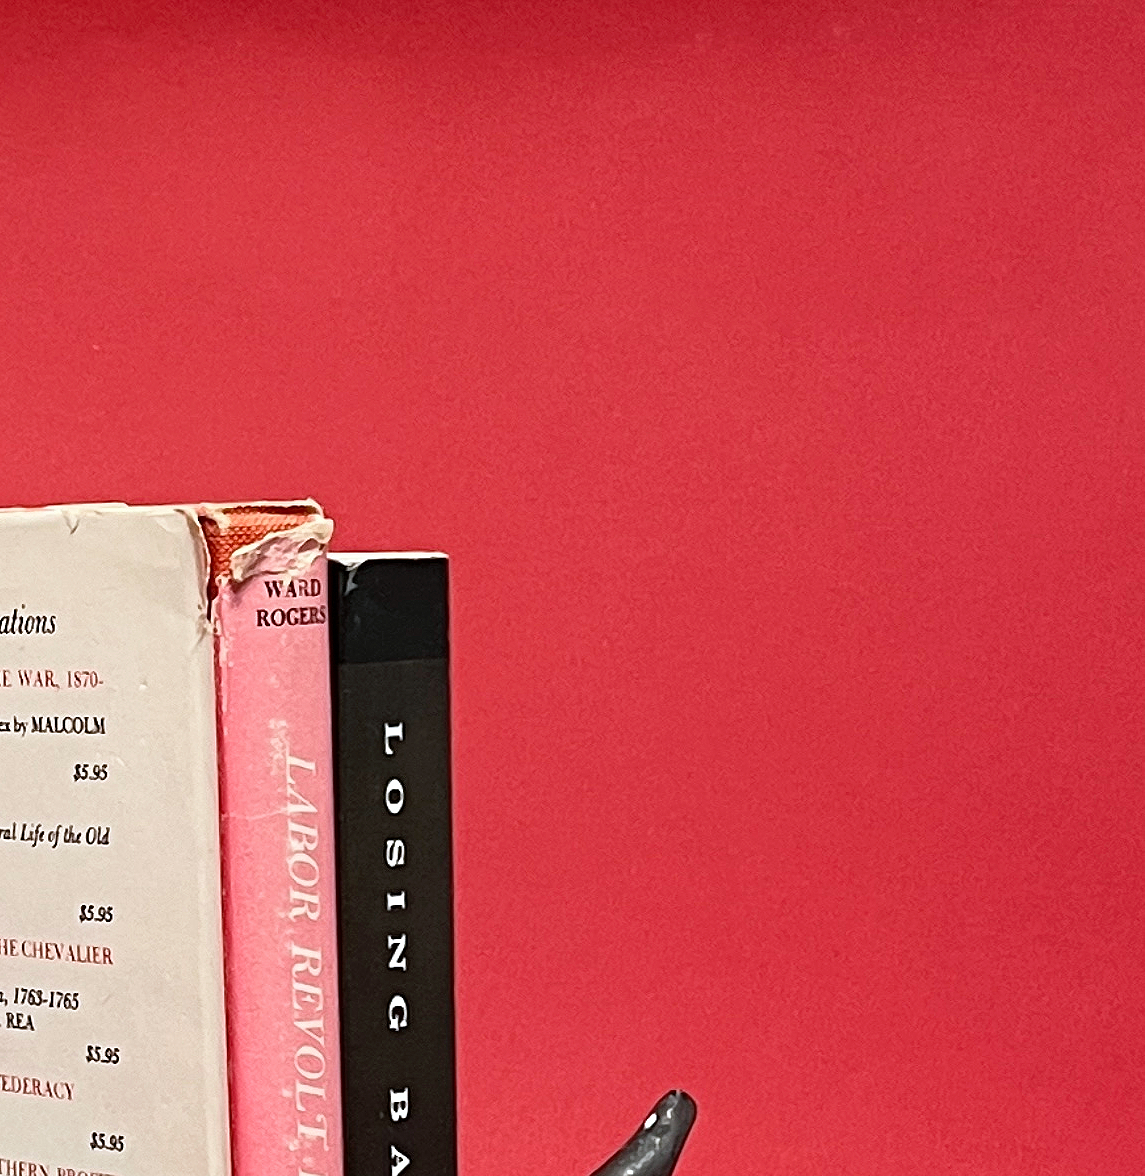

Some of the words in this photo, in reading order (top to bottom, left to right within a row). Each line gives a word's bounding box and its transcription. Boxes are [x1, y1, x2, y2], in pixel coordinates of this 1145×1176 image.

[264, 579, 321, 597] WARD
[257, 605, 326, 626] ROGERS
[18, 669, 60, 689] WAR,
[67, 669, 104, 688] 1870-
[14, 716, 27, 735] by
[31, 716, 105, 734] MALCOLM
[74, 763, 108, 781] $5.95
[20, 824, 44, 847] Life
[48, 826, 62, 848] of
[64, 828, 81, 844] the
[86, 828, 110, 845] Old
[286, 754, 322, 923] LABOR
[384, 722, 407, 1032] LOSING
[80, 905, 113, 922] $5.95
[21, 940, 113, 965] CHEVALIER
[14, 987, 79, 1010] 1763-1765
[6, 1013, 35, 1032] REA
[86, 1046, 120, 1064] $5.95
[290, 941, 328, 1153] REVOLT
[90, 1133, 124, 1151] $5.95
